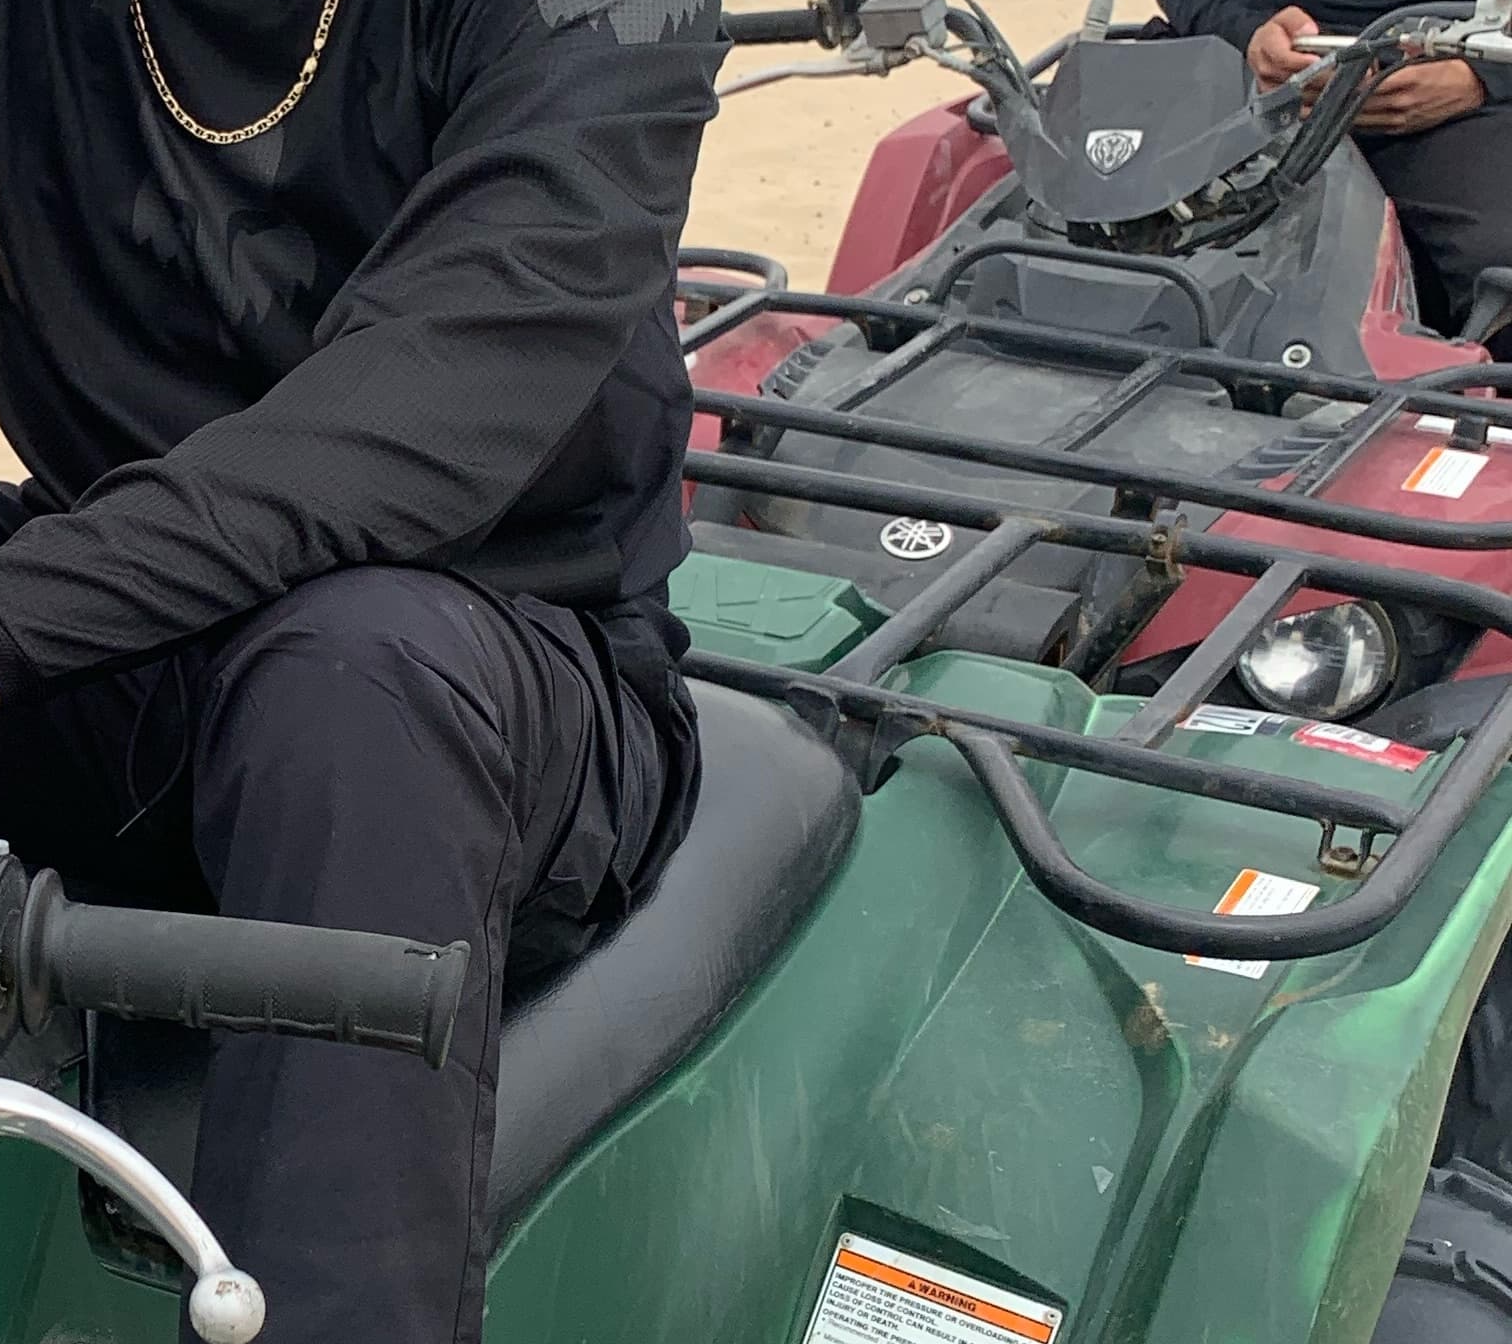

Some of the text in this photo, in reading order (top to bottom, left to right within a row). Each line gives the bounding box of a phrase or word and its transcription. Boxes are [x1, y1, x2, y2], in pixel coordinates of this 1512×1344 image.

[831, 1280, 859, 1295] CAUSE
[860, 1291, 882, 1304] LOSS
[883, 1300, 895, 1309] OF
[834, 1272, 877, 1293] IMPROPER
[878, 1288, 898, 1300] TIRE
[899, 1296, 943, 1317] PRESSURE
[944, 1313, 957, 1323] OR
[917, 1283, 977, 1312] WARNING
[828, 1289, 850, 1302] LOSS
[851, 1297, 863, 1307] OF
[864, 1302, 904, 1322] CONTROL
[905, 1318, 923, 1330] CAN
[924, 1325, 957, 1343] RESULT
[856, 1309, 869, 1319] OR
